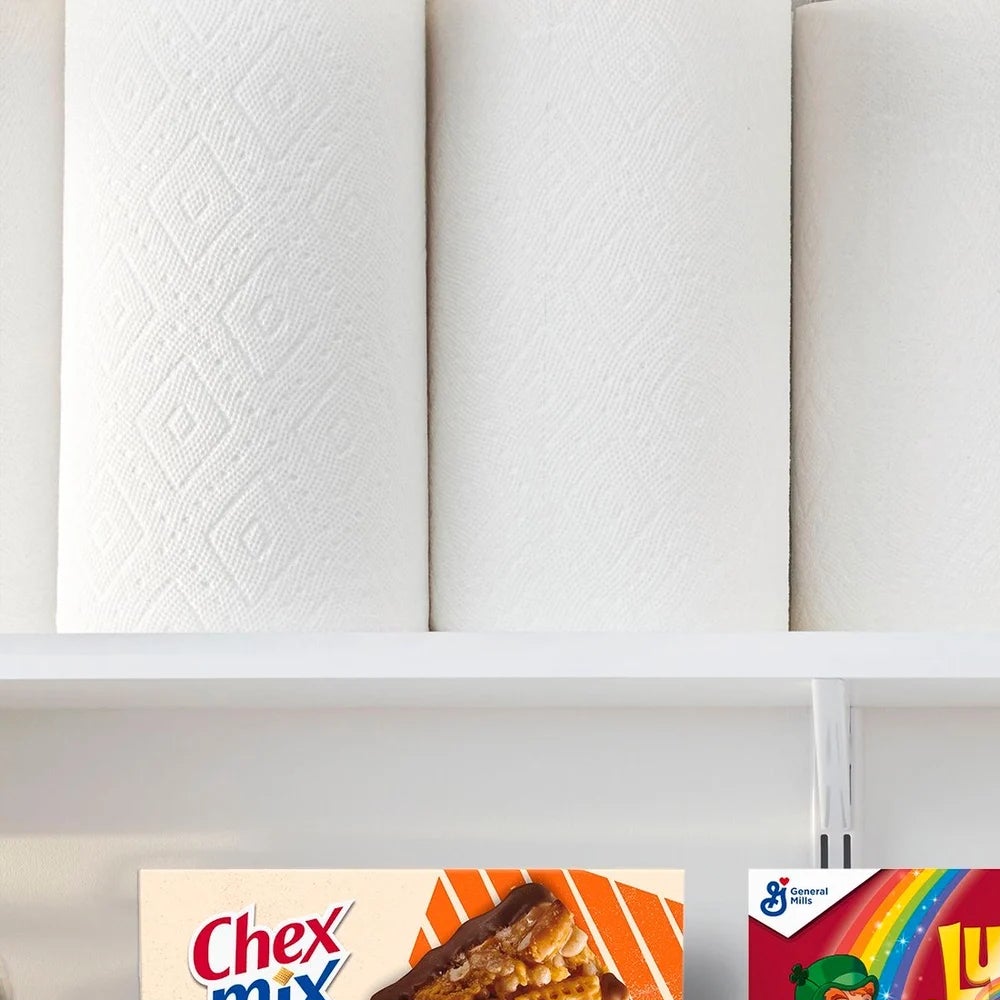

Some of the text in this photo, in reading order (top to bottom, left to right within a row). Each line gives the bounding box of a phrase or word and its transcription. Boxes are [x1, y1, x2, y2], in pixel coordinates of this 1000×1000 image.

[790, 887, 828, 896] General
[790, 896, 813, 905] Mills
[193, 906, 343, 981] Chex
